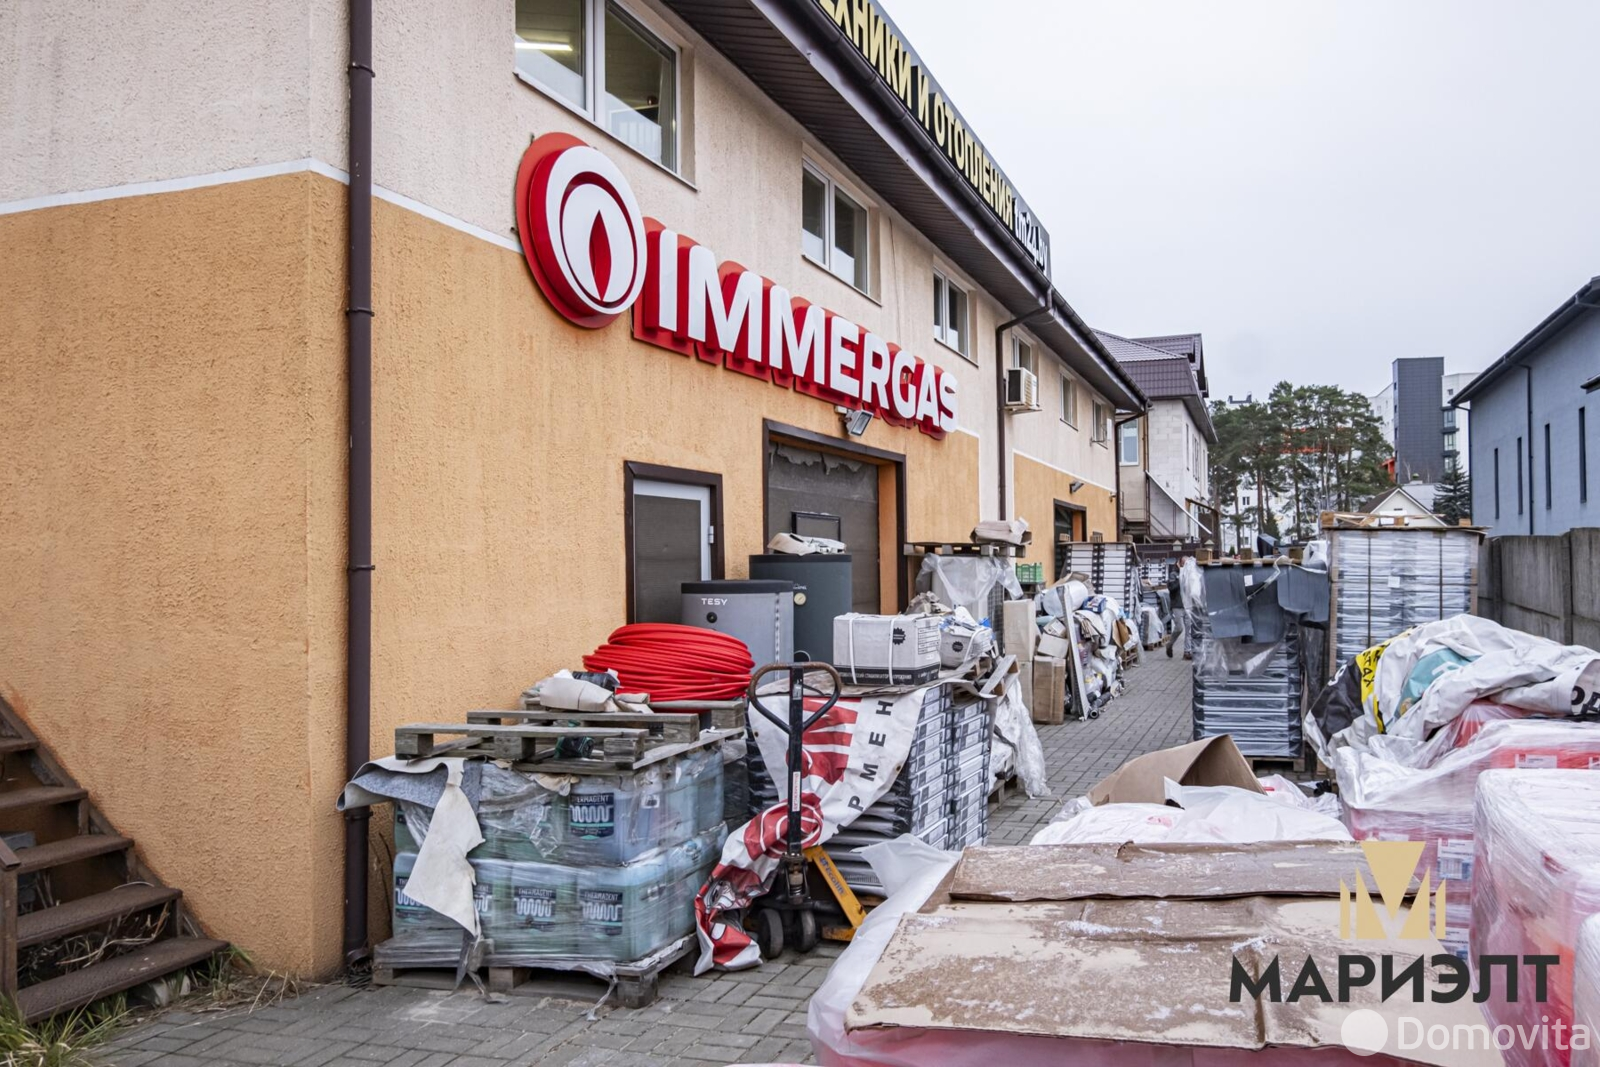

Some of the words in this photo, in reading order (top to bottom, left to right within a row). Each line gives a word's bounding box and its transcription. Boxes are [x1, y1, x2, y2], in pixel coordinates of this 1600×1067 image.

[917, 64, 930, 131] И
[934, 91, 1013, 231] ОТОПЛЕНИЯ
[658, 228, 959, 433] IMMERGAS
[701, 597, 728, 606] TESY
